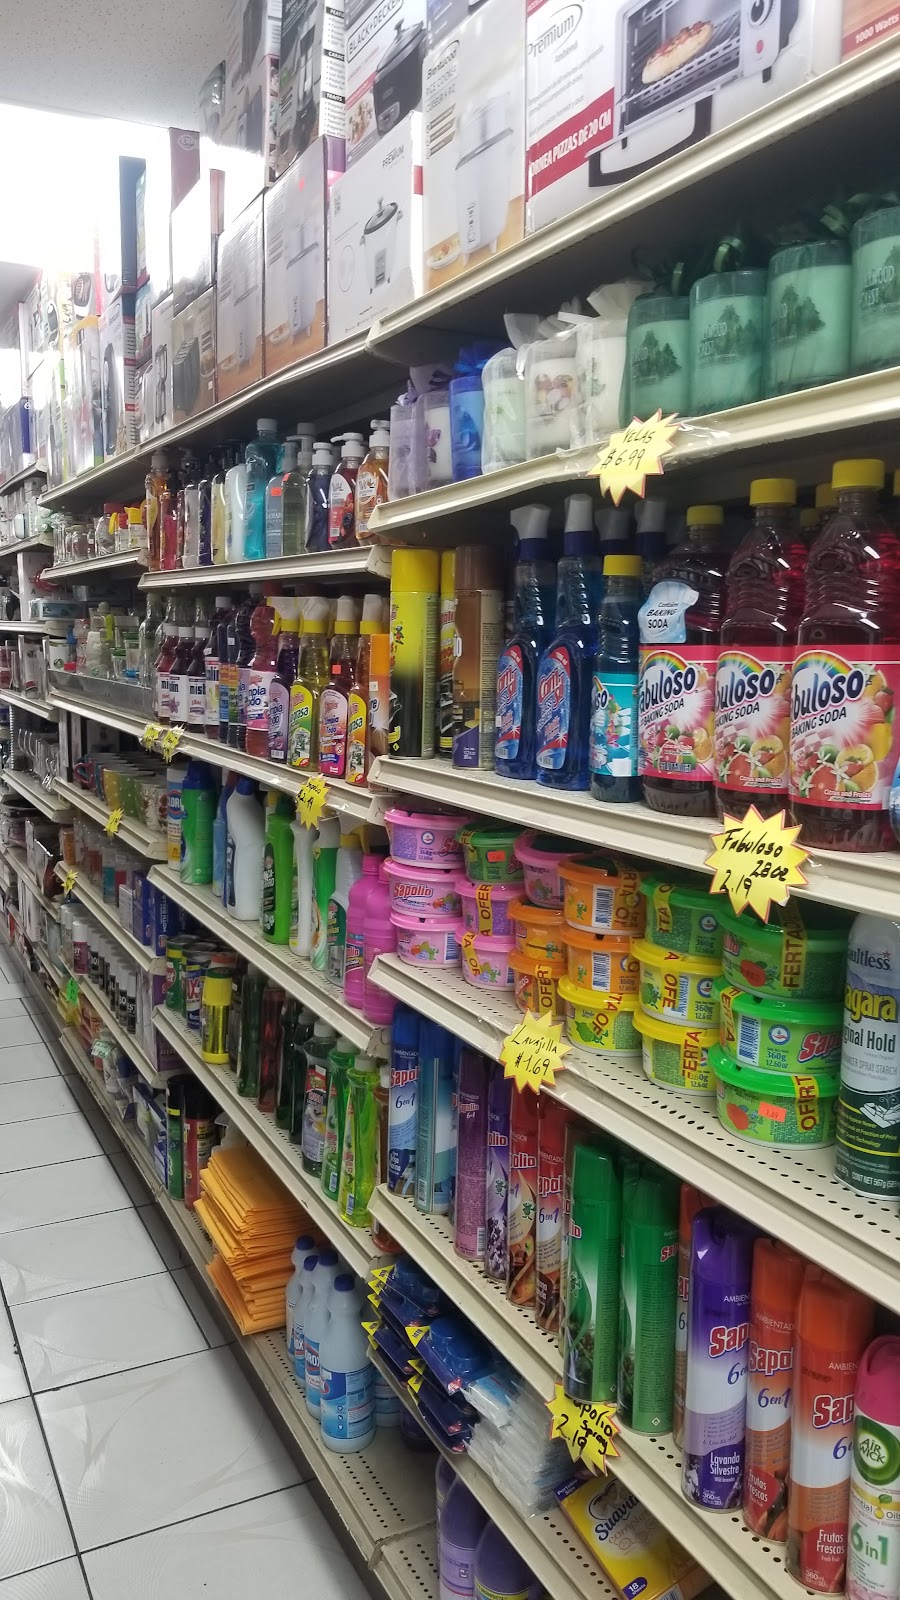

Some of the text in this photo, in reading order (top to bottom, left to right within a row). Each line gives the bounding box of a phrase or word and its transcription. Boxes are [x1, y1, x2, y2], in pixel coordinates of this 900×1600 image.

[528, 14, 574, 58] Premium
[855, 14, 900, 44] 1000 Watts
[426, 49, 457, 80] Brentwood
[553, 132, 578, 162] PIZZAS
[578, 125, 588, 146] DE
[588, 118, 598, 139] 20
[598, 109, 612, 131] CM
[381, 144, 405, 169] PREMIUM
[622, 426, 657, 444] VELAS
[600, 448, 646, 472] $6.99
[646, 608, 677, 617] BAKING
[648, 619, 669, 629] SODA
[643, 698, 685, 726] BAKING SODA
[734, 701, 760, 720] SODA
[818, 706, 847, 727] SODA
[823, 789, 840, 797] Citrus
[853, 790, 872, 798] Fruits
[721, 827, 783, 858] Fabuloso
[393, 881, 433, 900] Sapolio
[719, 870, 752, 899] 2.19
[694, 1004, 714, 1015] 360g
[511, 1025, 557, 1054] Lavajilla
[866, 1030, 896, 1053] Hold
[765, 1050, 788, 1063] 360g
[765, 1059, 781, 1068] 12.60
[859, 1058, 898, 1076] SPRAY STARCH
[873, 1178, 887, 1189] 567g
[710, 1451, 740, 1464] Lavanda
[858, 1442, 886, 1465] WICK
[709, 1463, 740, 1476] Silvestre
[557, 1479, 578, 1496] Portable
[818, 1529, 844, 1543] Frutas
[851, 1523, 889, 1566] 6 in 1
[816, 1540, 845, 1555] Frescas
[628, 1582, 639, 1593] 18
[632, 1583, 647, 1596] sheets
